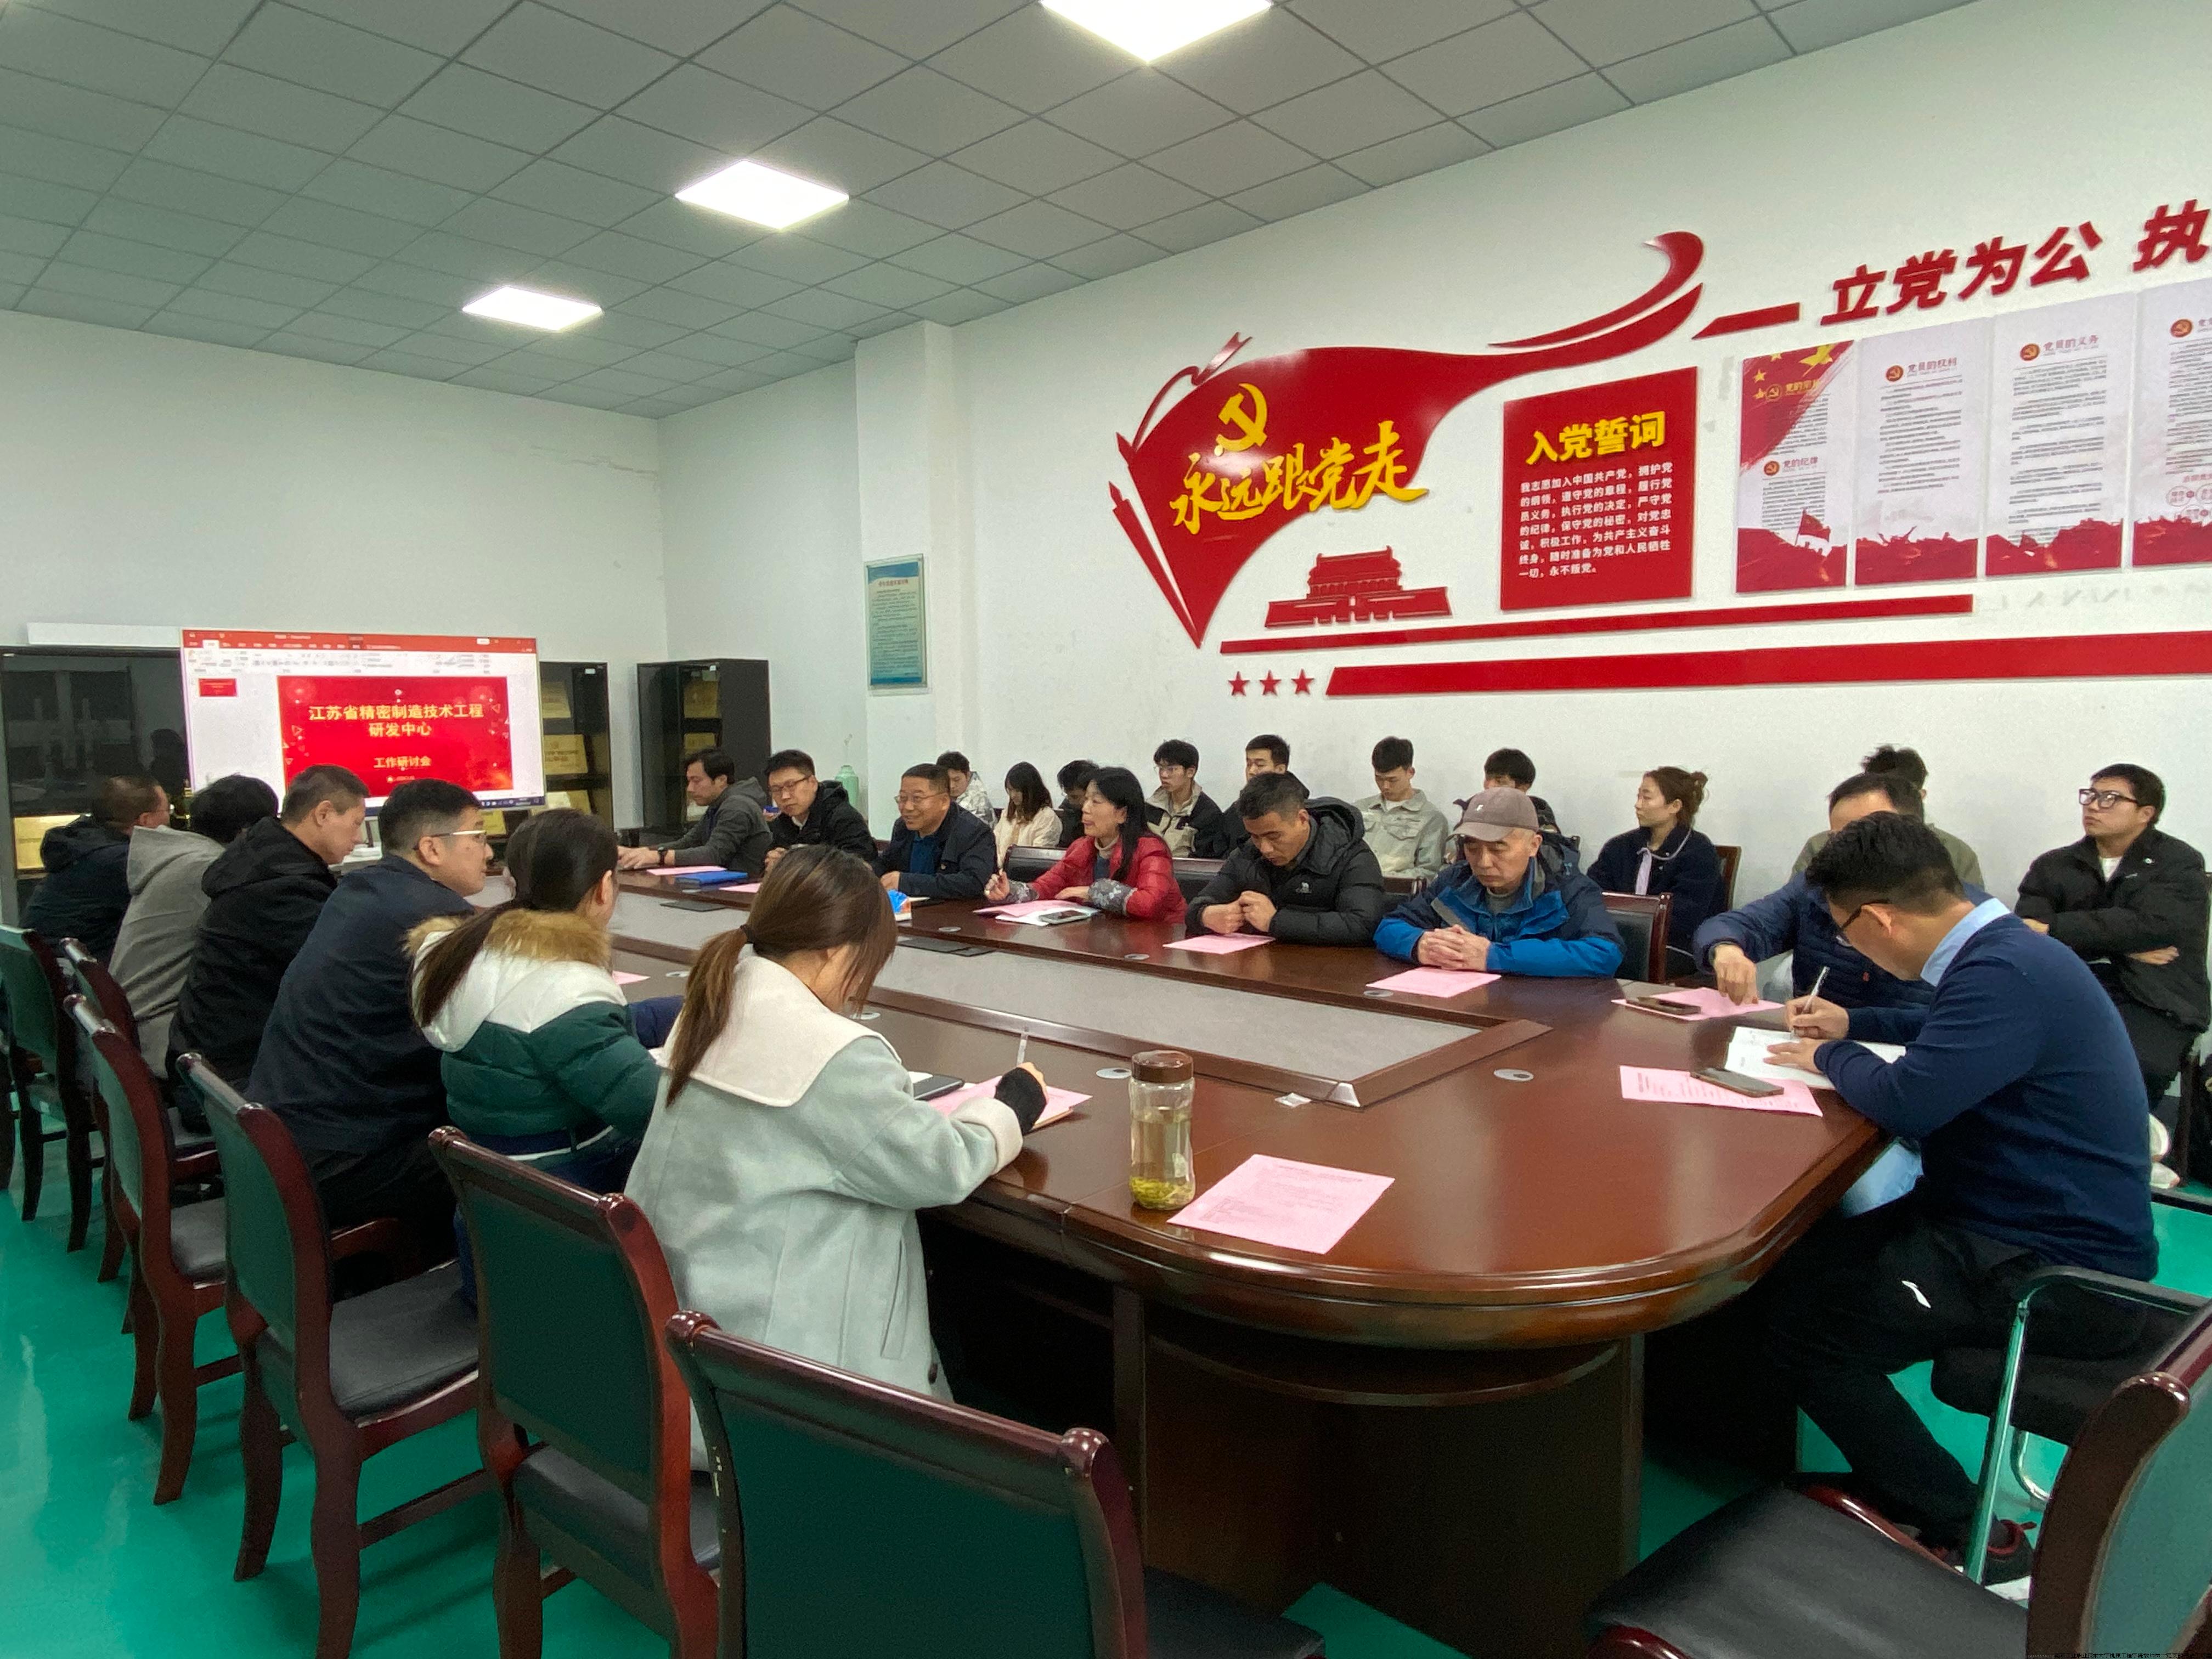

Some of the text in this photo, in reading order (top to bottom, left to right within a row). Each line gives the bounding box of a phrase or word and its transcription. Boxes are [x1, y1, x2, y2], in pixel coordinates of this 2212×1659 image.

[1820, 199, 2211, 326] 立党为公 执
[1526, 410, 1666, 465] 入党誓词
[1169, 420, 1429, 534] 永远跟党走
[308, 703, 484, 721] 江苏省精密制造技术工程
[368, 721, 432, 737] 研发中心
[373, 755, 432, 769] 工作研讨会
